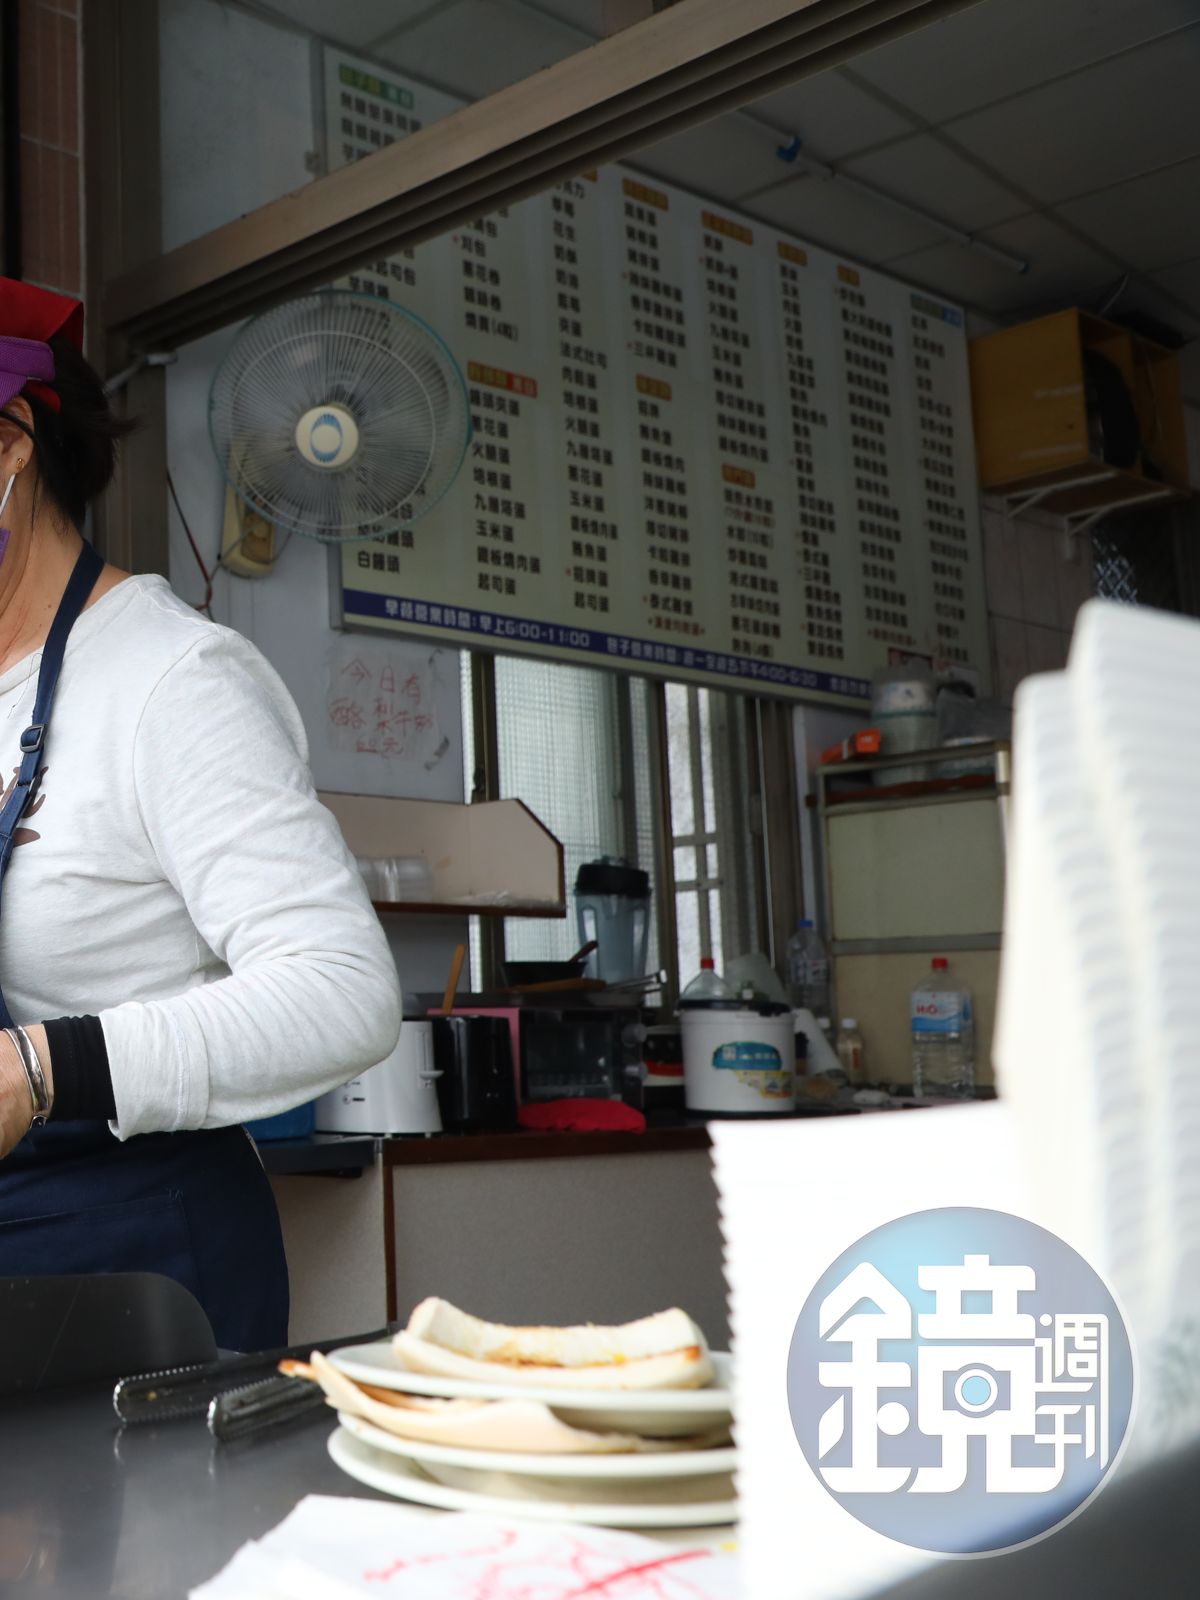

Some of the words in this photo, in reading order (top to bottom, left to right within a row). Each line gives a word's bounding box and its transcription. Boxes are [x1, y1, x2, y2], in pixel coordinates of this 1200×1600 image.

[560, 341, 607, 369] 法式吐司
[470, 388, 520, 417] 饅頭夾蛋
[472, 415, 508, 439] 蔥花蛋
[566, 416, 600, 438] 火腿蛋
[473, 441, 509, 465] 火腿蛋
[567, 440, 613, 465] 九層塔蛋
[474, 466, 511, 490] 培根蛋
[475, 493, 526, 519] 九層塔蛋
[570, 490, 604, 512] 玉米蛋
[476, 519, 514, 542] 玉米蛋
[357, 550, 400, 575] 白饅頭
[477, 545, 541, 574] 鐵板燒肉蛋
[479, 572, 516, 595] 起司蛋
[575, 591, 609, 613] 起司蛋
